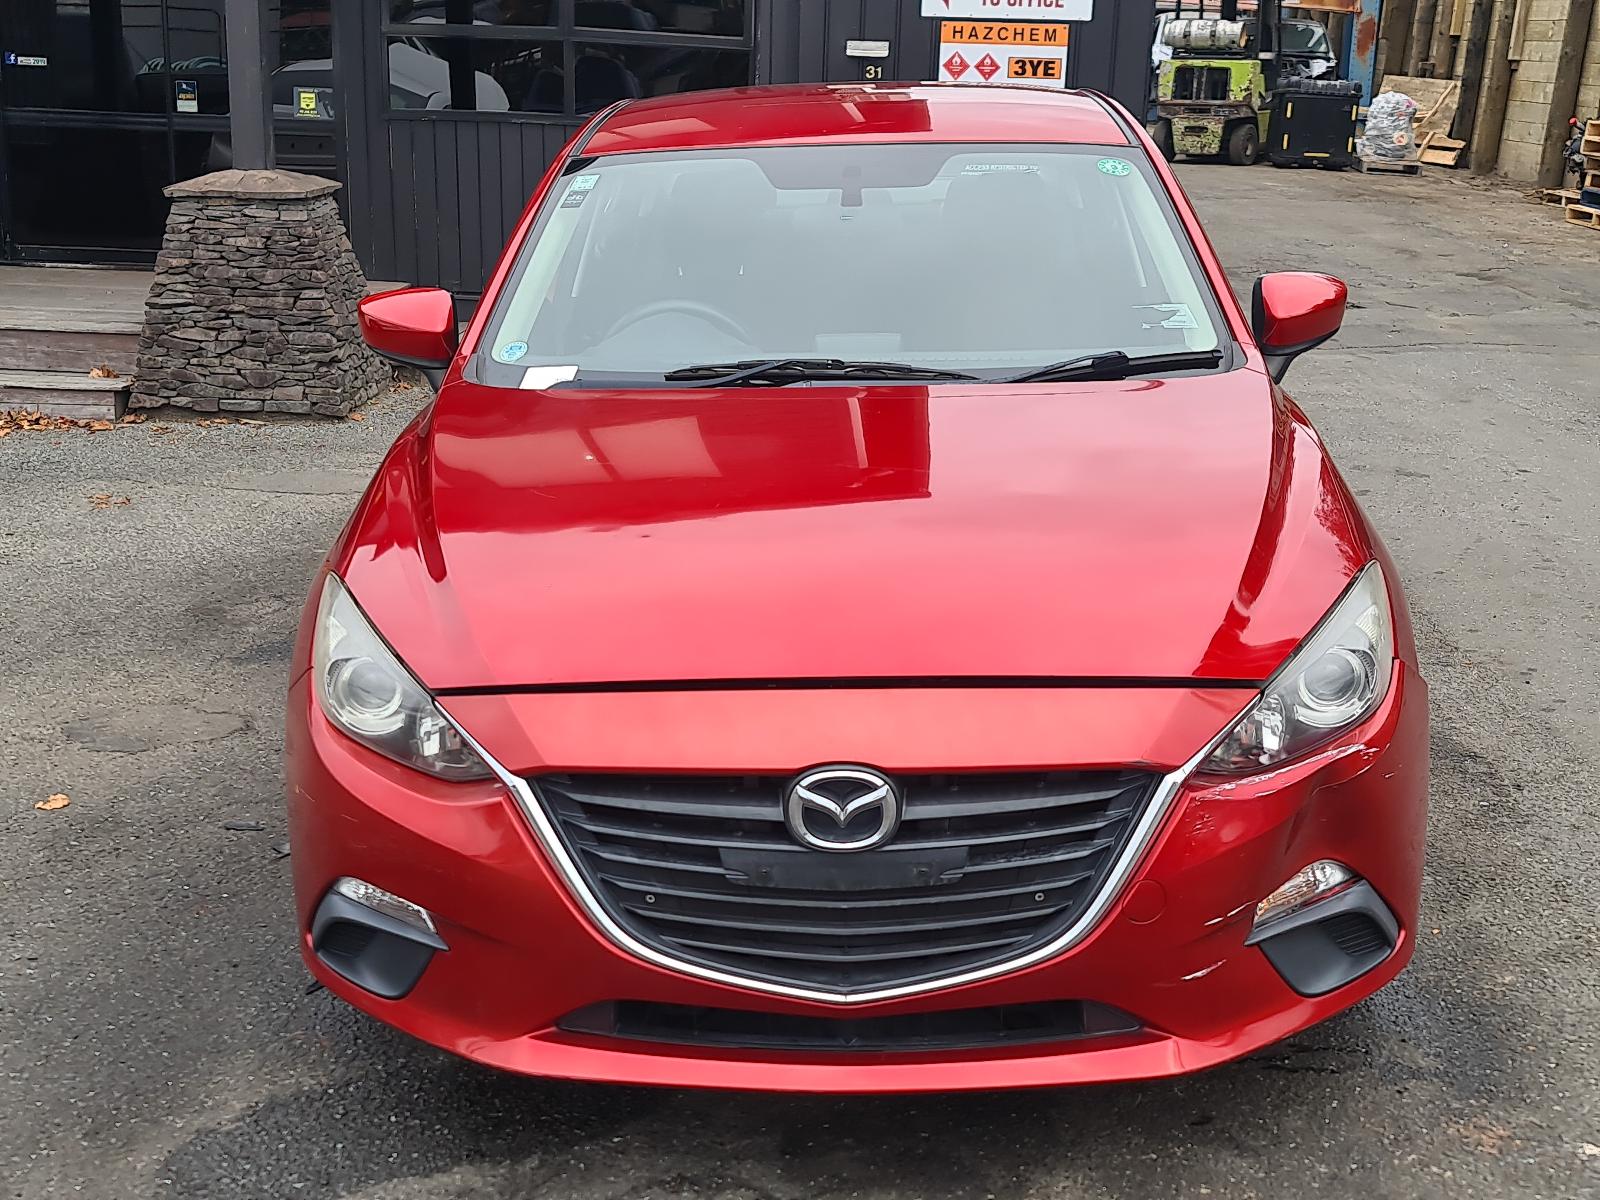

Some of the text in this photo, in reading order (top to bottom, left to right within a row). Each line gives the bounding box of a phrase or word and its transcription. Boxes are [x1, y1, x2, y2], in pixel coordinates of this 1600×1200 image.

[952, 26, 1057, 42] HAZCHEM
[865, 66, 882, 79] 31
[1013, 59, 1056, 77] 3YE
